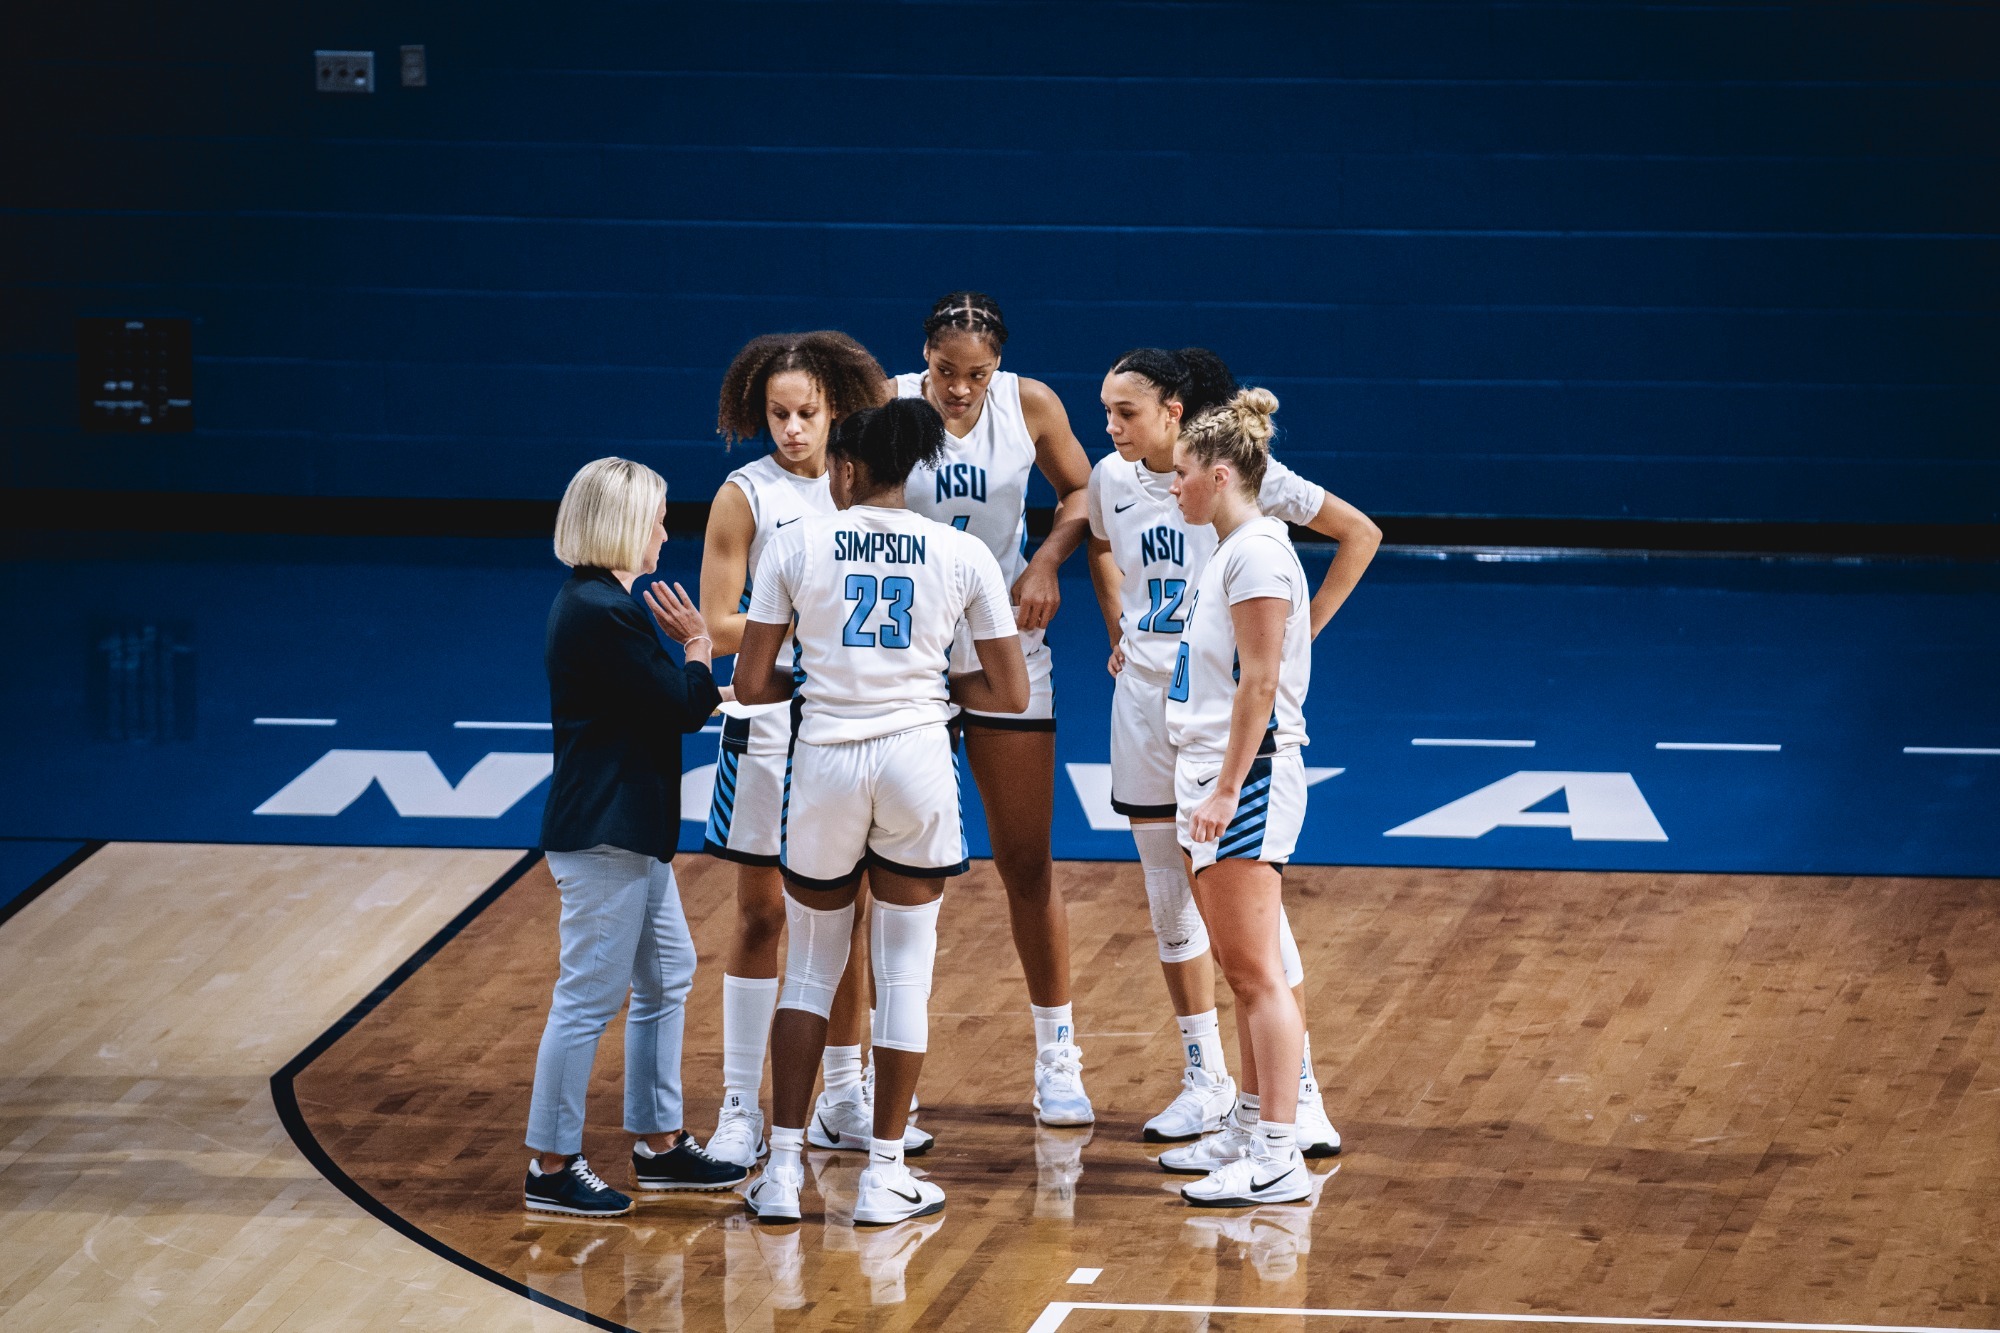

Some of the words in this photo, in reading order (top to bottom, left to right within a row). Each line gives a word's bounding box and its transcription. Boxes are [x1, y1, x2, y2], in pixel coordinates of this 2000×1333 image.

[936, 463, 987, 504] NSU
[834, 530, 926, 565] SIMPSON
[1141, 525, 1184, 568] NSU
[842, 574, 915, 649] 23
[1138, 578, 1187, 633] 12
